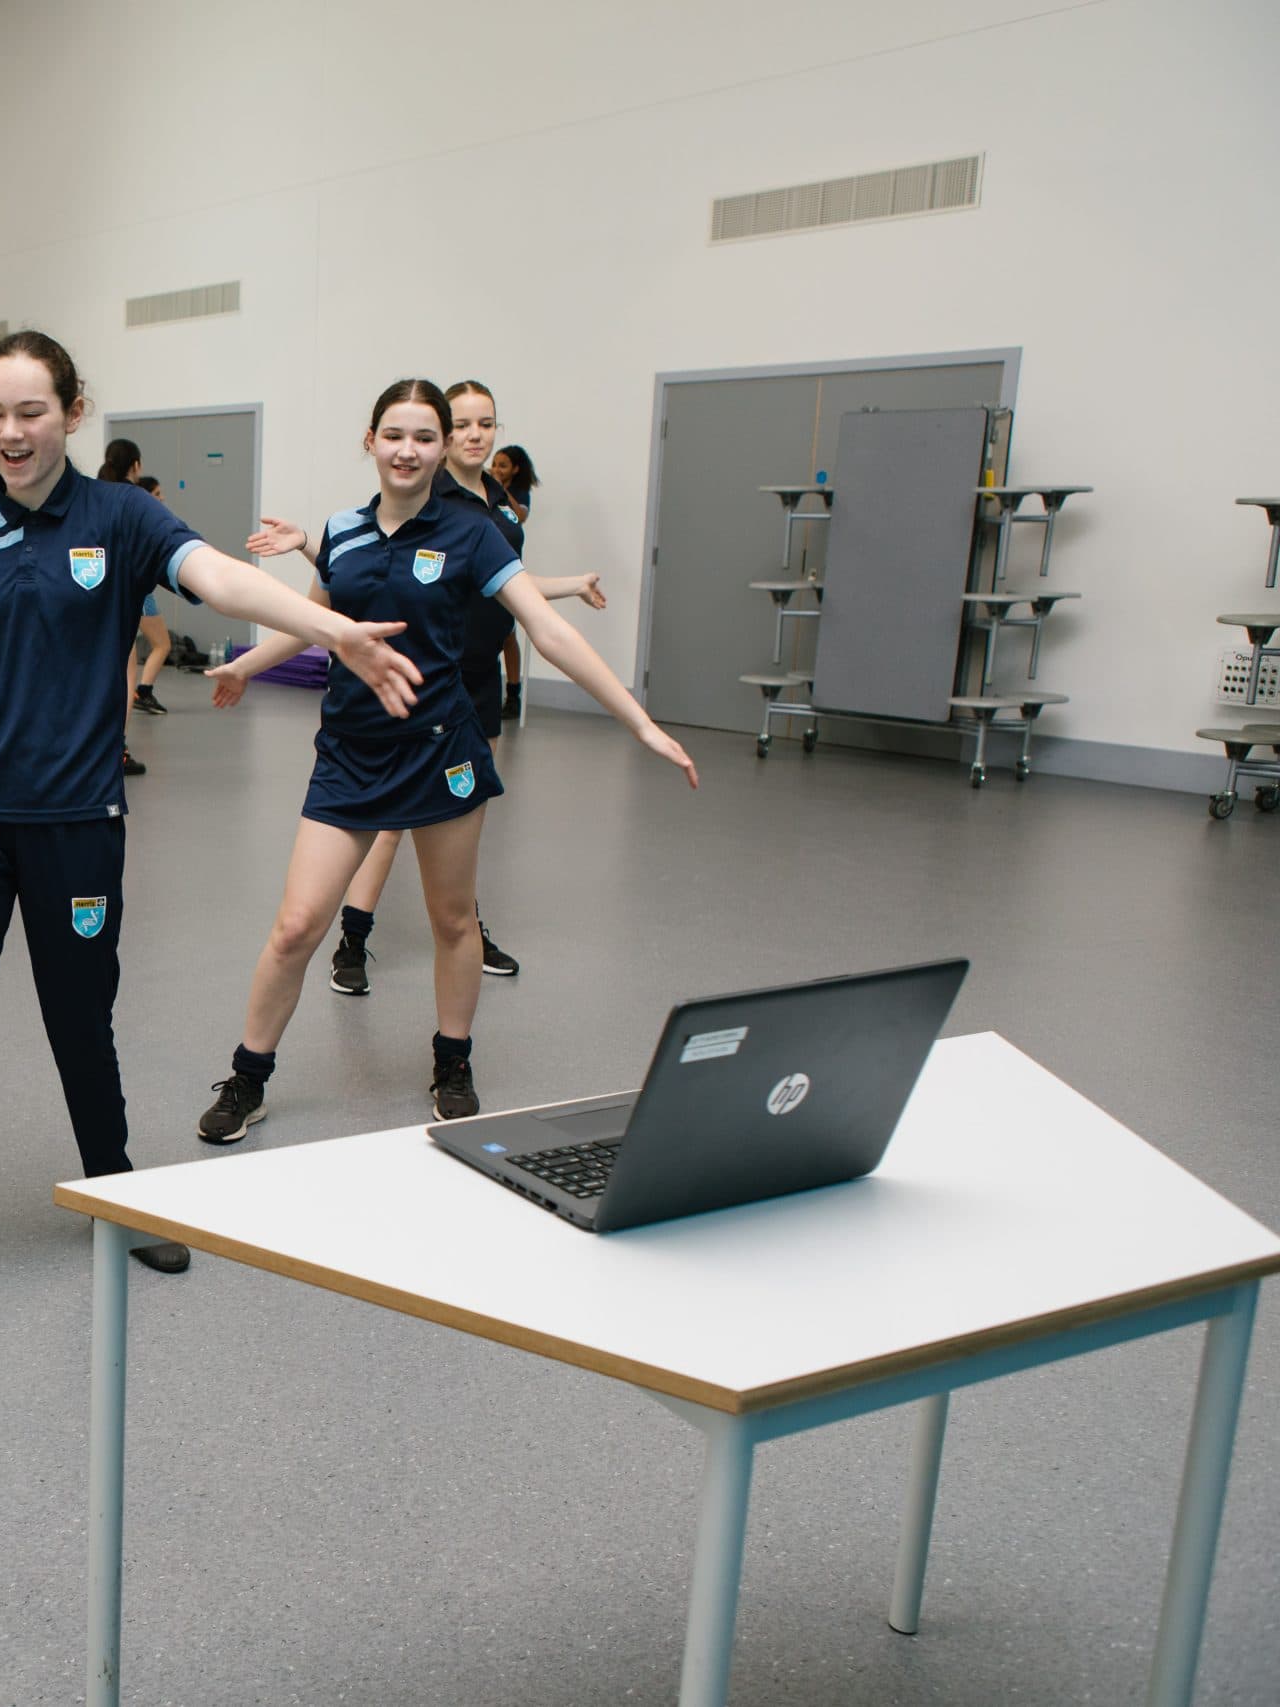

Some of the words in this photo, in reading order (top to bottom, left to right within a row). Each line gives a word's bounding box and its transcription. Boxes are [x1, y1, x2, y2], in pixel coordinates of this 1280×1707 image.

[72, 551, 94, 559] Harris
[74, 899, 96, 908] Harris
[769, 1074, 808, 1114] hp
